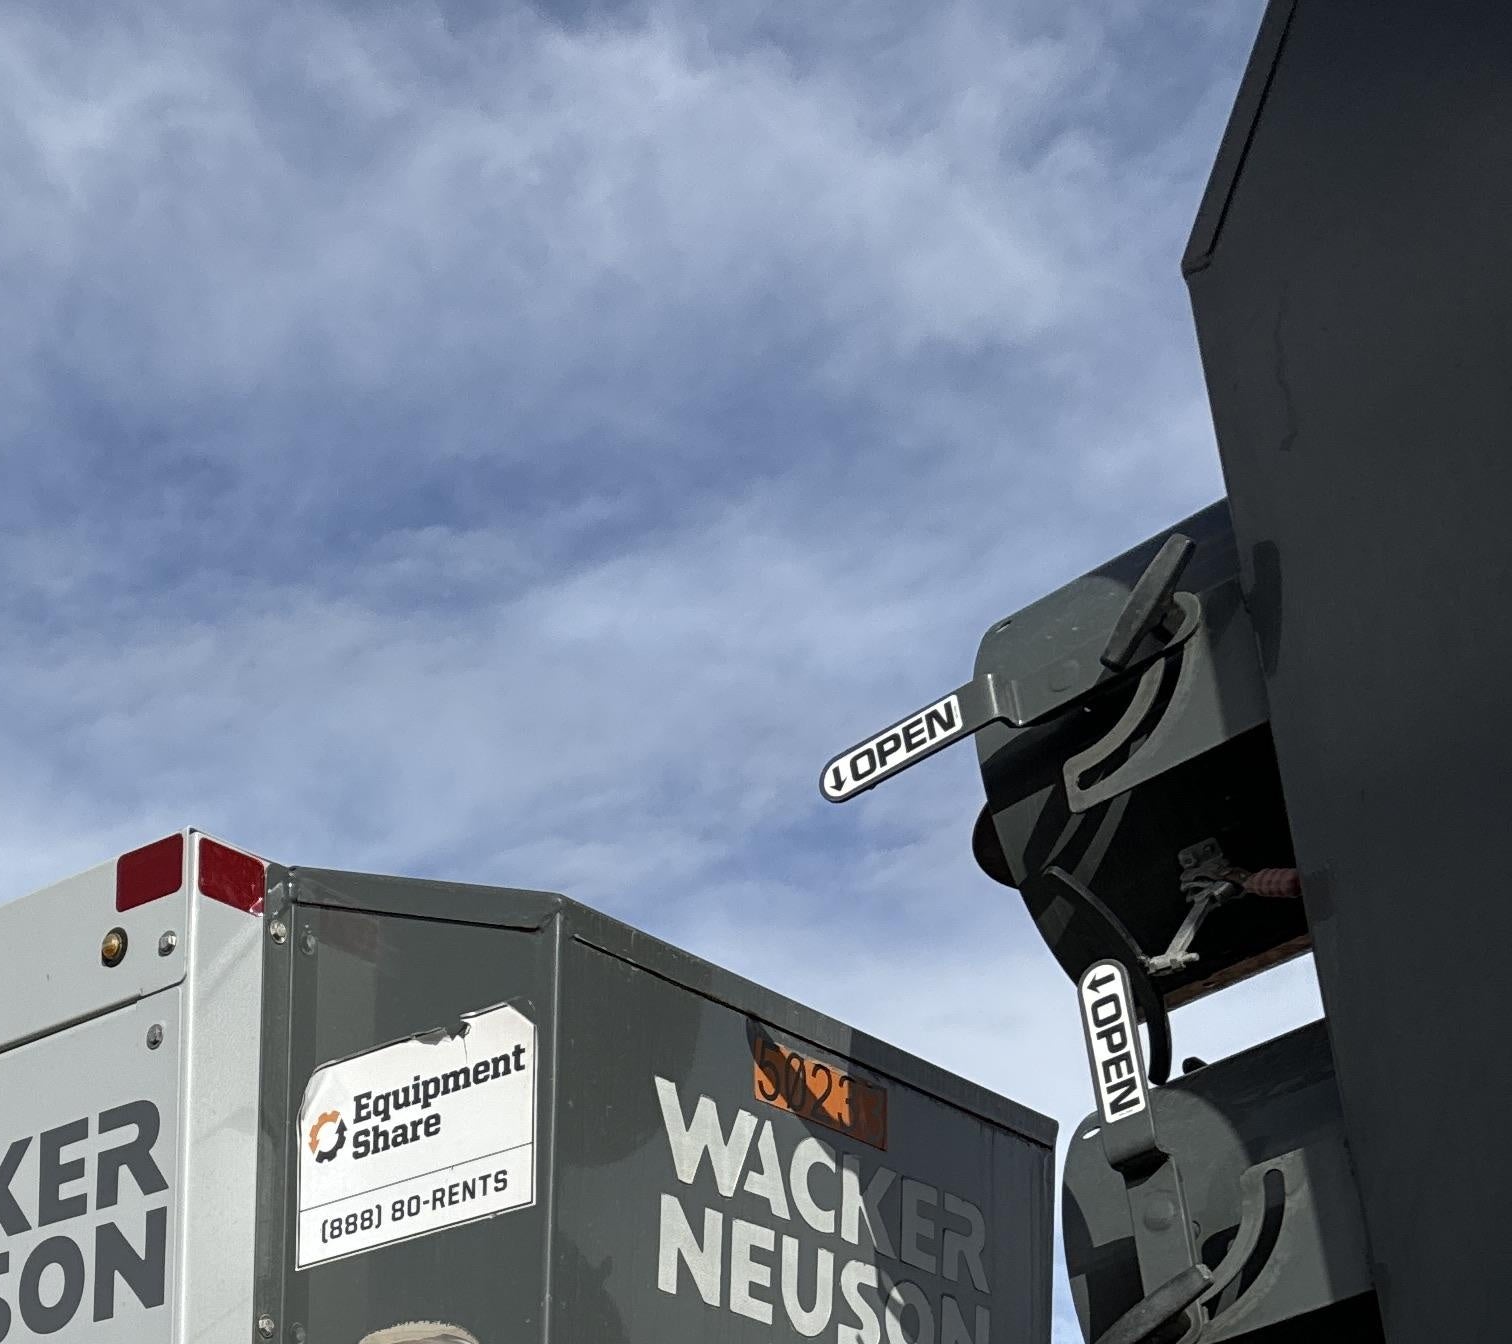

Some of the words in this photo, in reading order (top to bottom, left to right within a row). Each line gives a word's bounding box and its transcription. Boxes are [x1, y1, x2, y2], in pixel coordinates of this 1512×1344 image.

[849, 700, 956, 782] OPEN
[353, 1044, 526, 1124] Equipment
[1091, 993, 1141, 1115] OPEN
[352, 1113, 441, 1160] Share
[322, 1204, 381, 1243] (888)
[391, 1169, 508, 1222] 80-RENTS
[654, 1075, 990, 1294] WACKER
